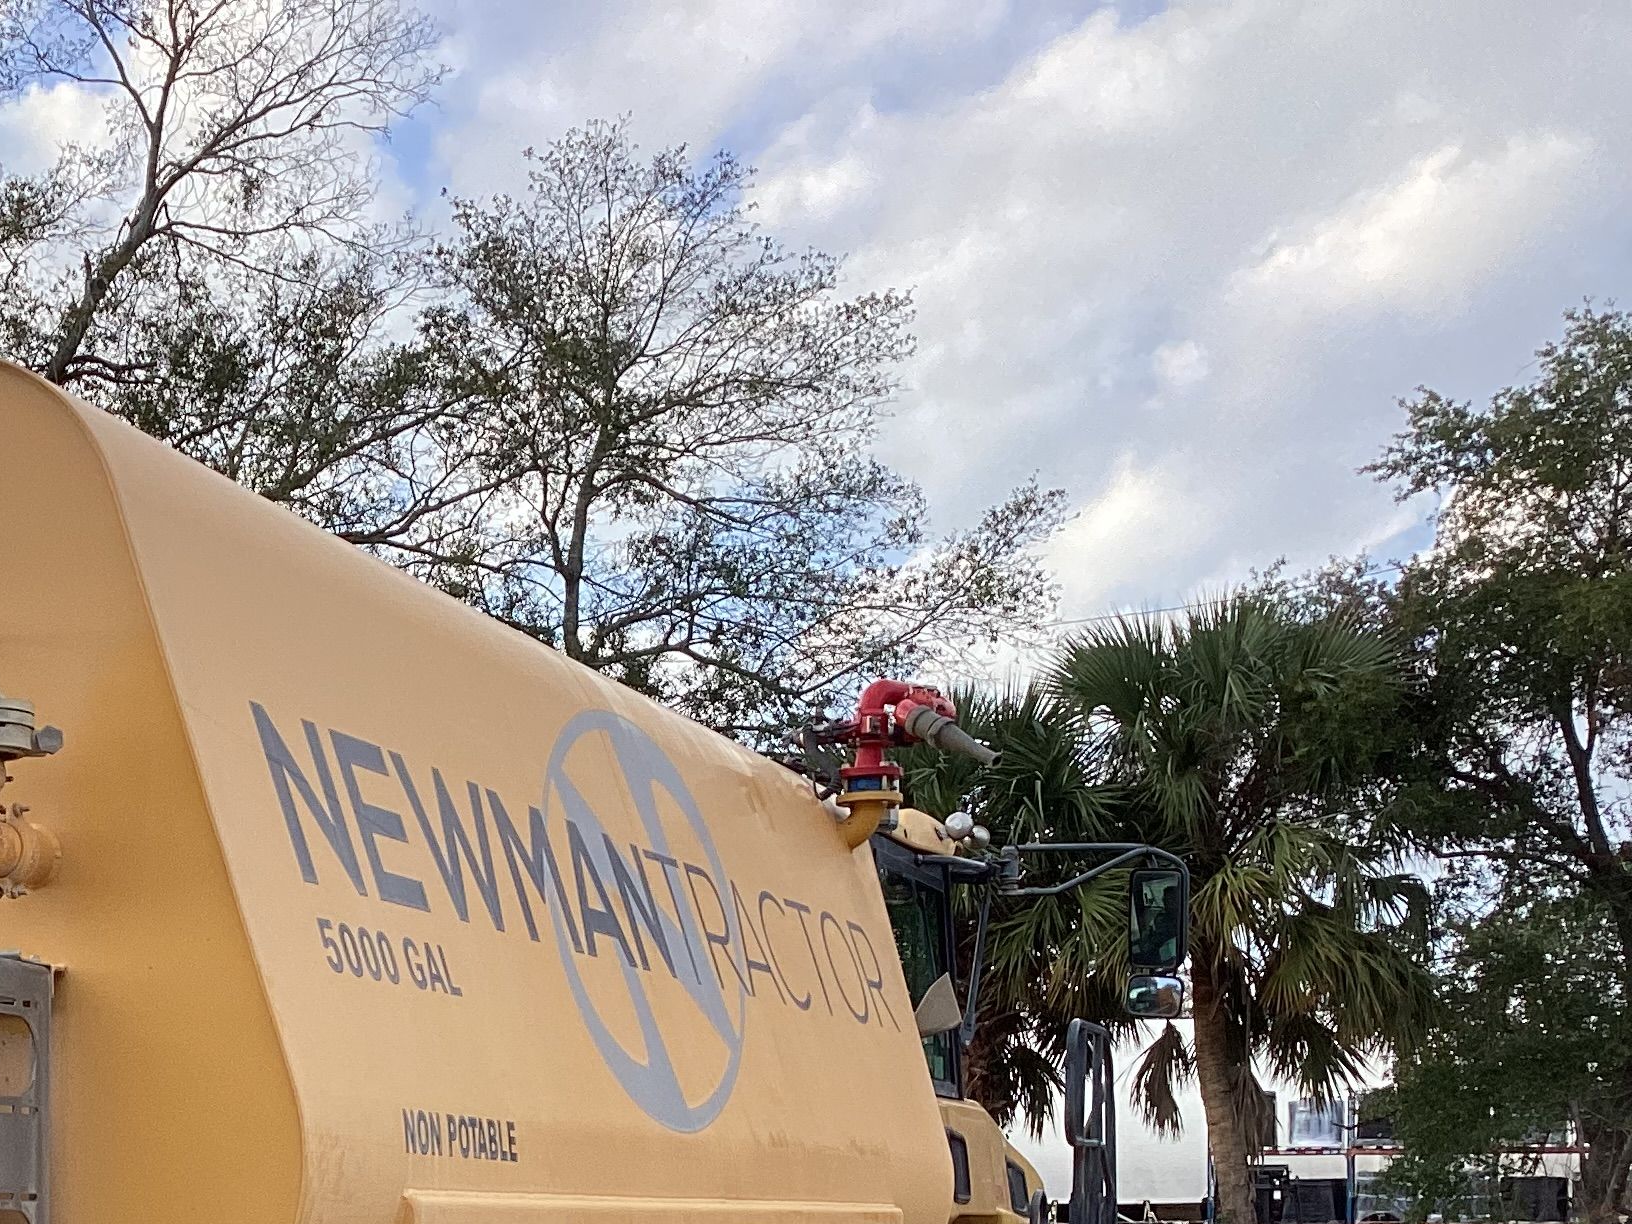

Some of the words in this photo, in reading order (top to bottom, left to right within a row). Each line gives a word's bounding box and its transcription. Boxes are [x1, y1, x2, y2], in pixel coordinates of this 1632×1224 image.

[316, 917, 400, 985] 5000
[402, 936, 464, 997] GAL
[402, 1108, 443, 1157] NON
[446, 1113, 518, 1163] POTABLE
